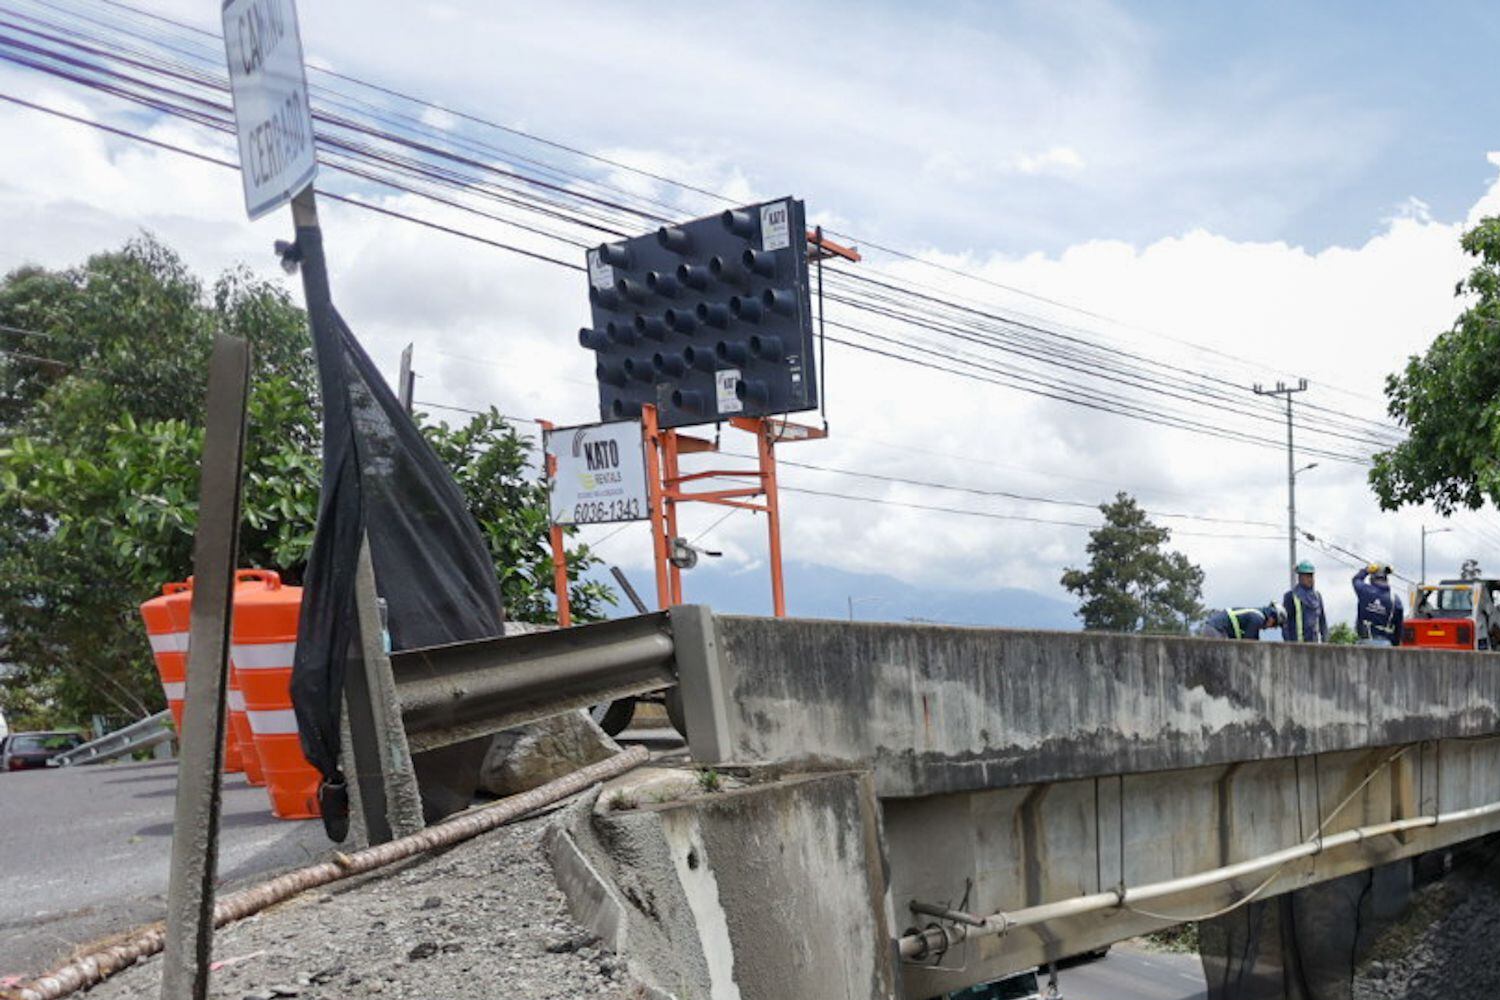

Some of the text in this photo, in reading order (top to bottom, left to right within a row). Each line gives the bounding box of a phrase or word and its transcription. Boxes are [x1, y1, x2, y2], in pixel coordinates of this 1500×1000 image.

[239, 0, 284, 74] CAMINO
[248, 90, 305, 188] CERRADO
[584, 438, 619, 471] KATO
[594, 471, 622, 485] RENTALS
[574, 498, 639, 522] 6036-1343
